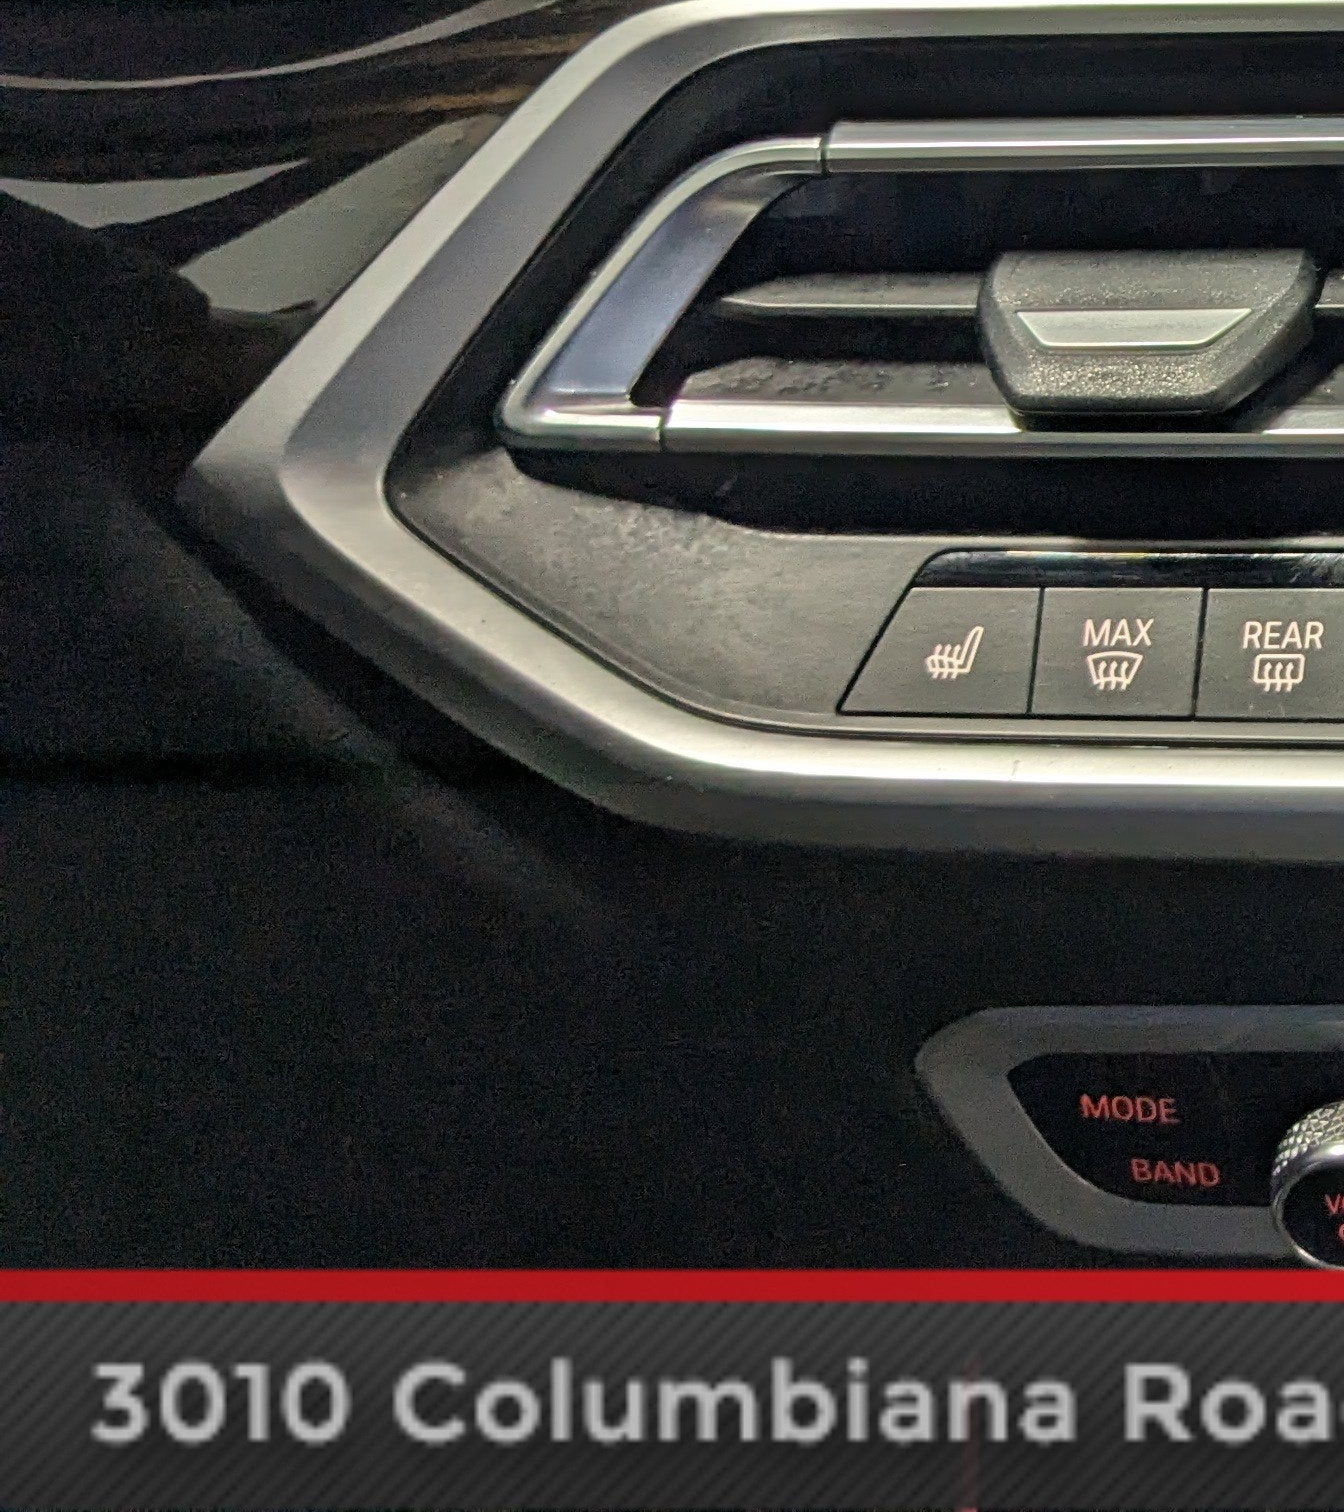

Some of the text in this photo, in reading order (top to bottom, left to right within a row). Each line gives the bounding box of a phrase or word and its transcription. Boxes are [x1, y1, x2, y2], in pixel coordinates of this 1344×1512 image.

[1081, 617, 1155, 648] MAX
[1241, 620, 1325, 651] REAR
[1079, 1093, 1180, 1125] MODE
[1130, 1157, 1221, 1187] BAND
